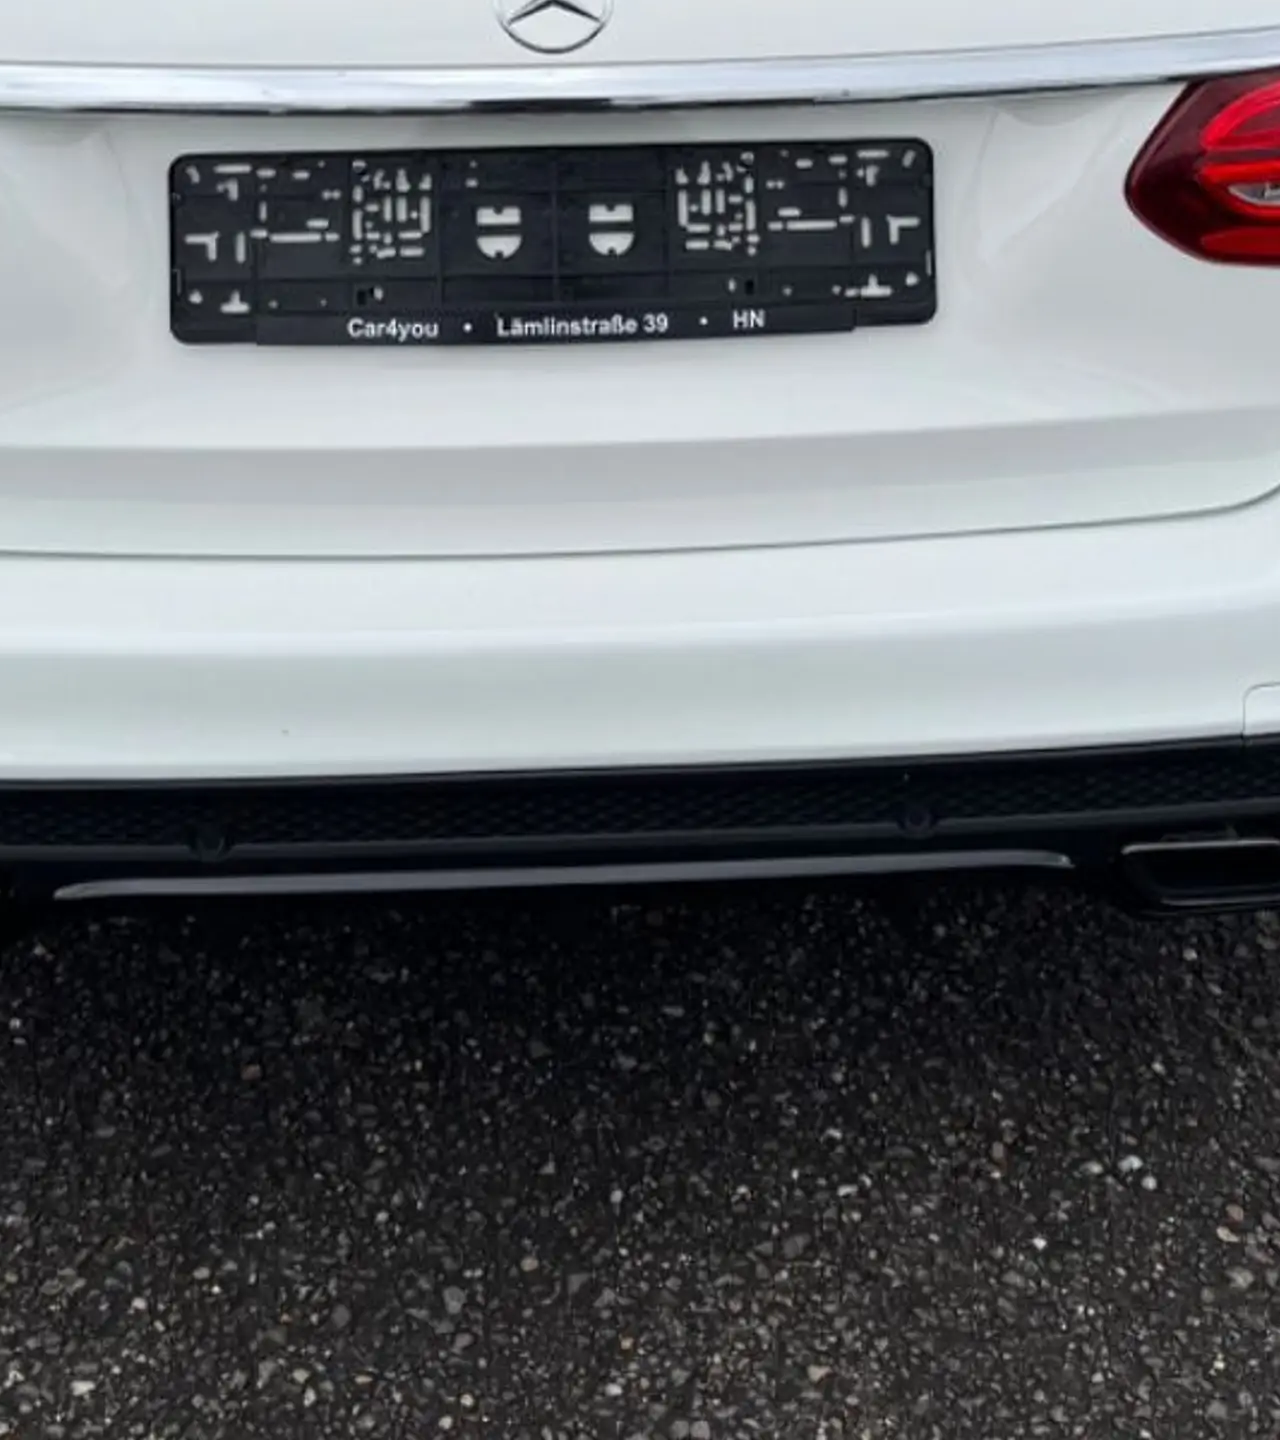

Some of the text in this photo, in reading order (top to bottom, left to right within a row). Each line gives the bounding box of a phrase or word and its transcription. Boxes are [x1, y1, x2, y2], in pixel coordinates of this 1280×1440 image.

[346, 309, 766, 342] Car4you Lämlinstraße 39 HN
